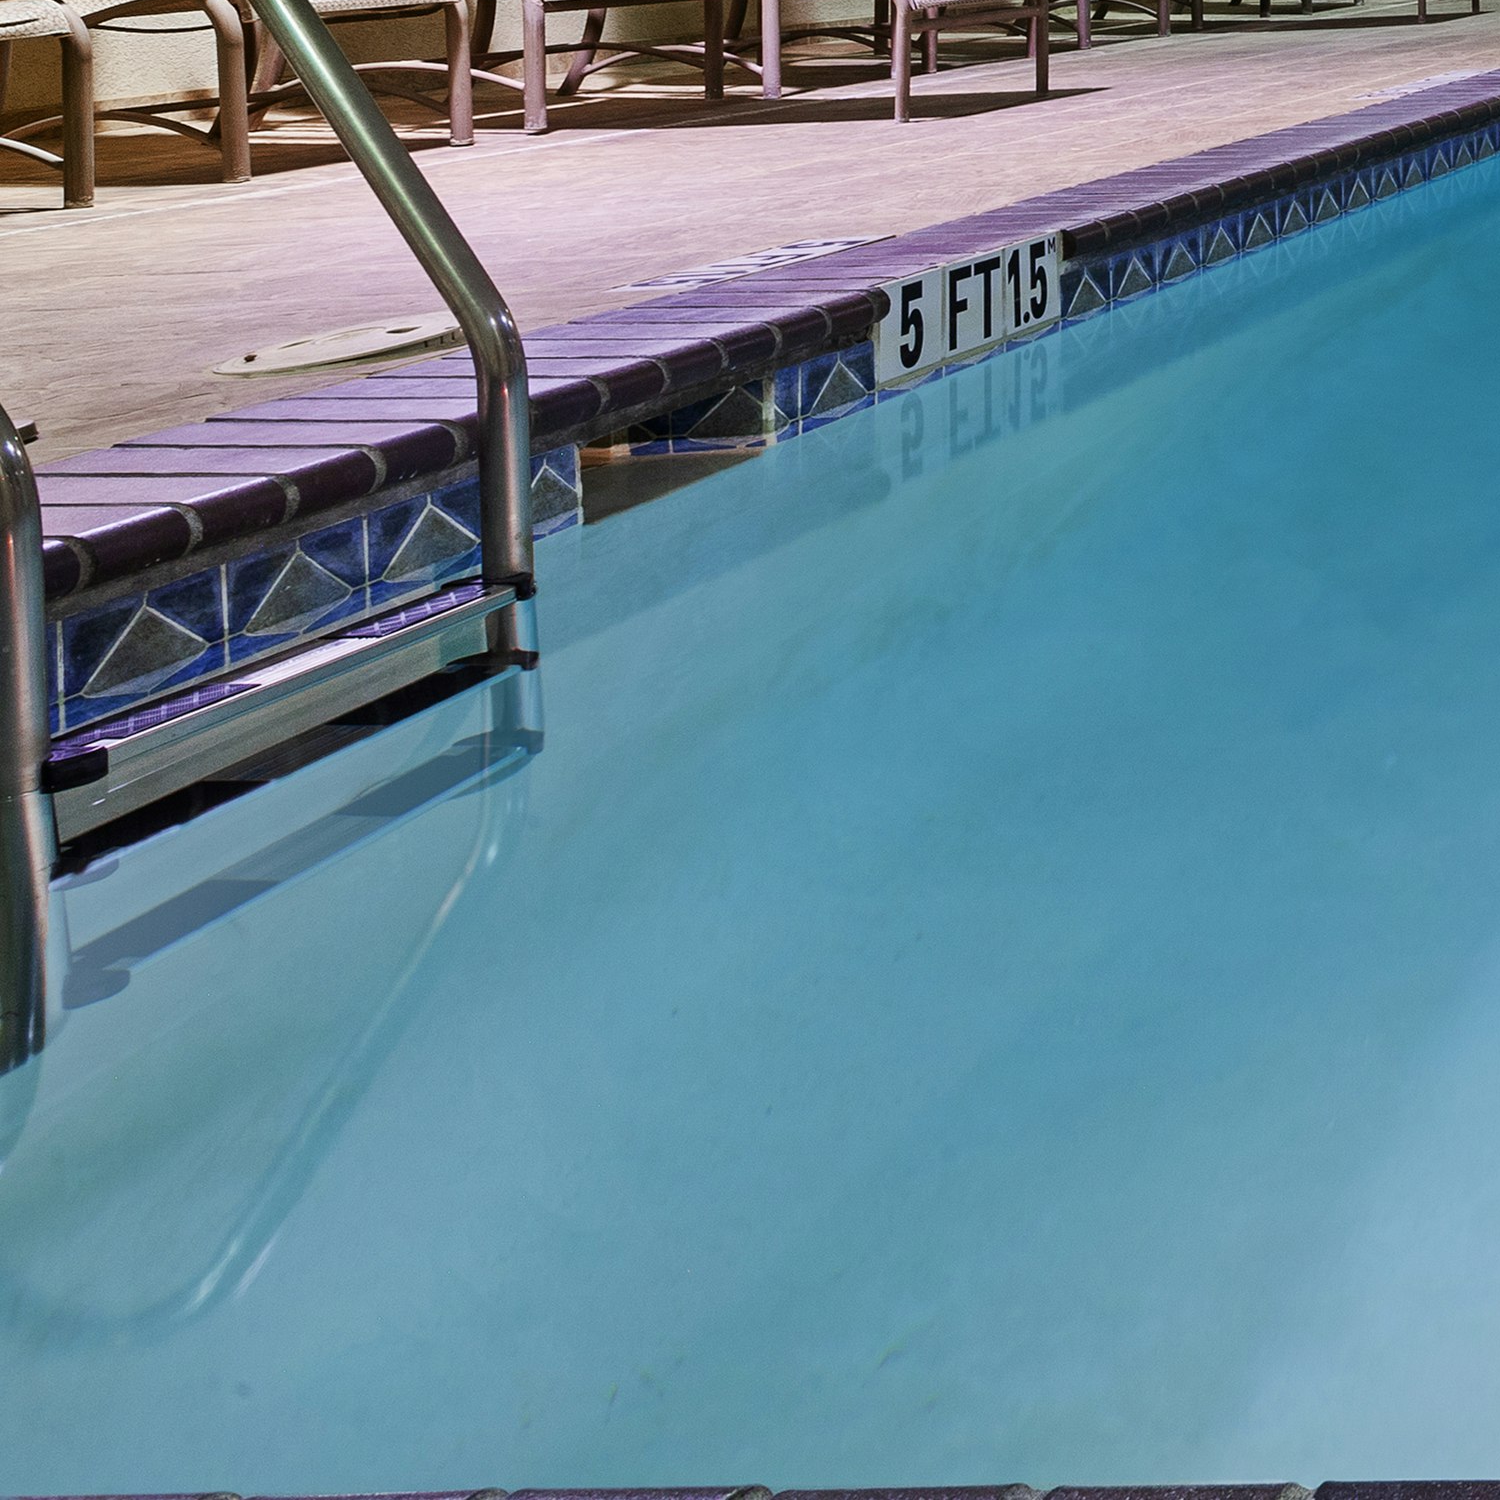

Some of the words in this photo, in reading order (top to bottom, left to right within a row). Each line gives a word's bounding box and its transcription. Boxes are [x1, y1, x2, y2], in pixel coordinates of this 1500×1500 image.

[900, 282, 924, 369] 5
[948, 256, 1000, 351] FT
[1007, 241, 1048, 328] 1.5
